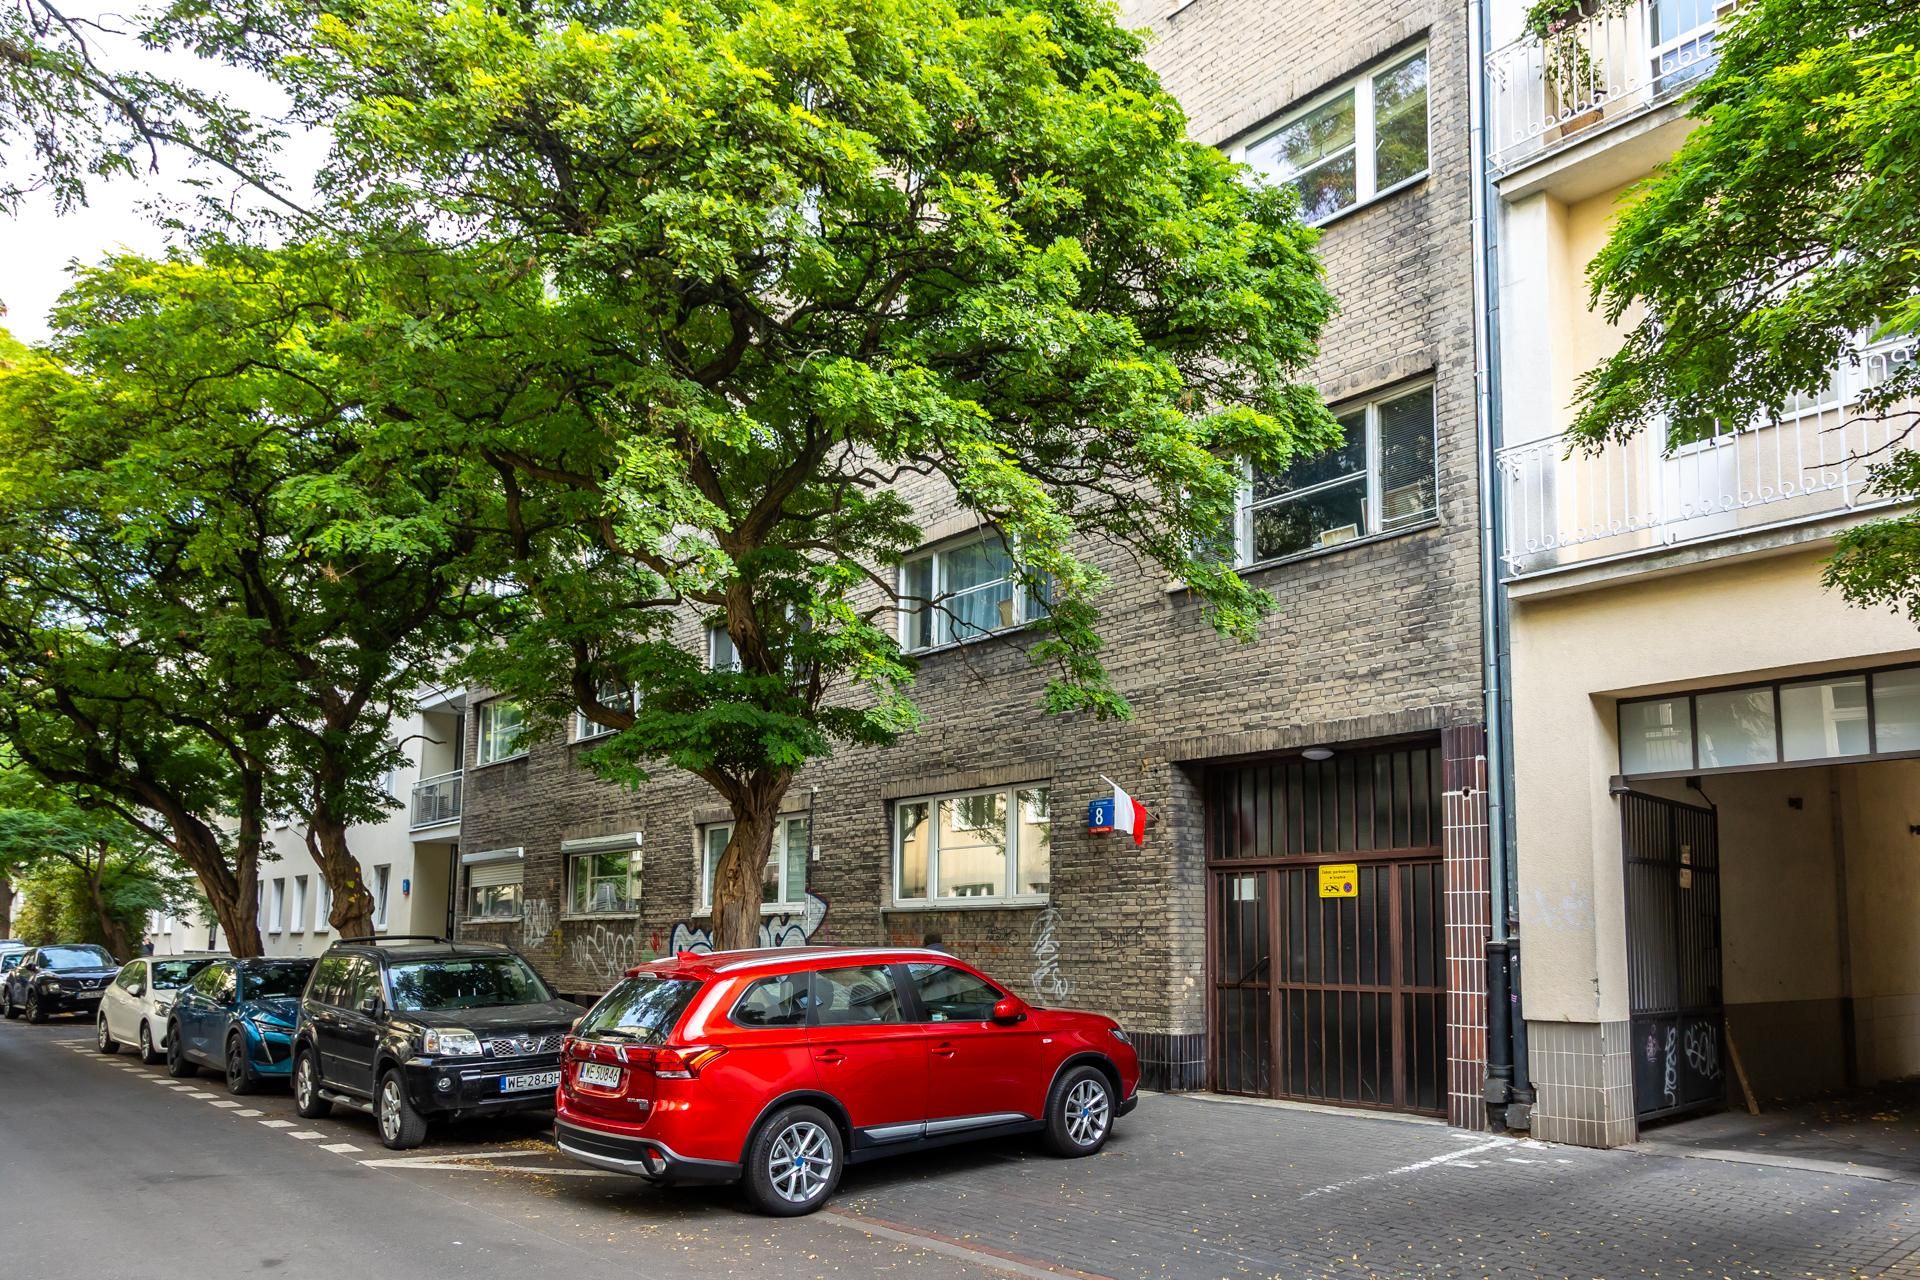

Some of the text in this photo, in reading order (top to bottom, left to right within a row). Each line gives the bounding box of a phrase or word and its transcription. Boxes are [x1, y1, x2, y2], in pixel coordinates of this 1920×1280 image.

[1095, 807, 1104, 825] 8
[507, 1072, 561, 1088] WE 2843H
